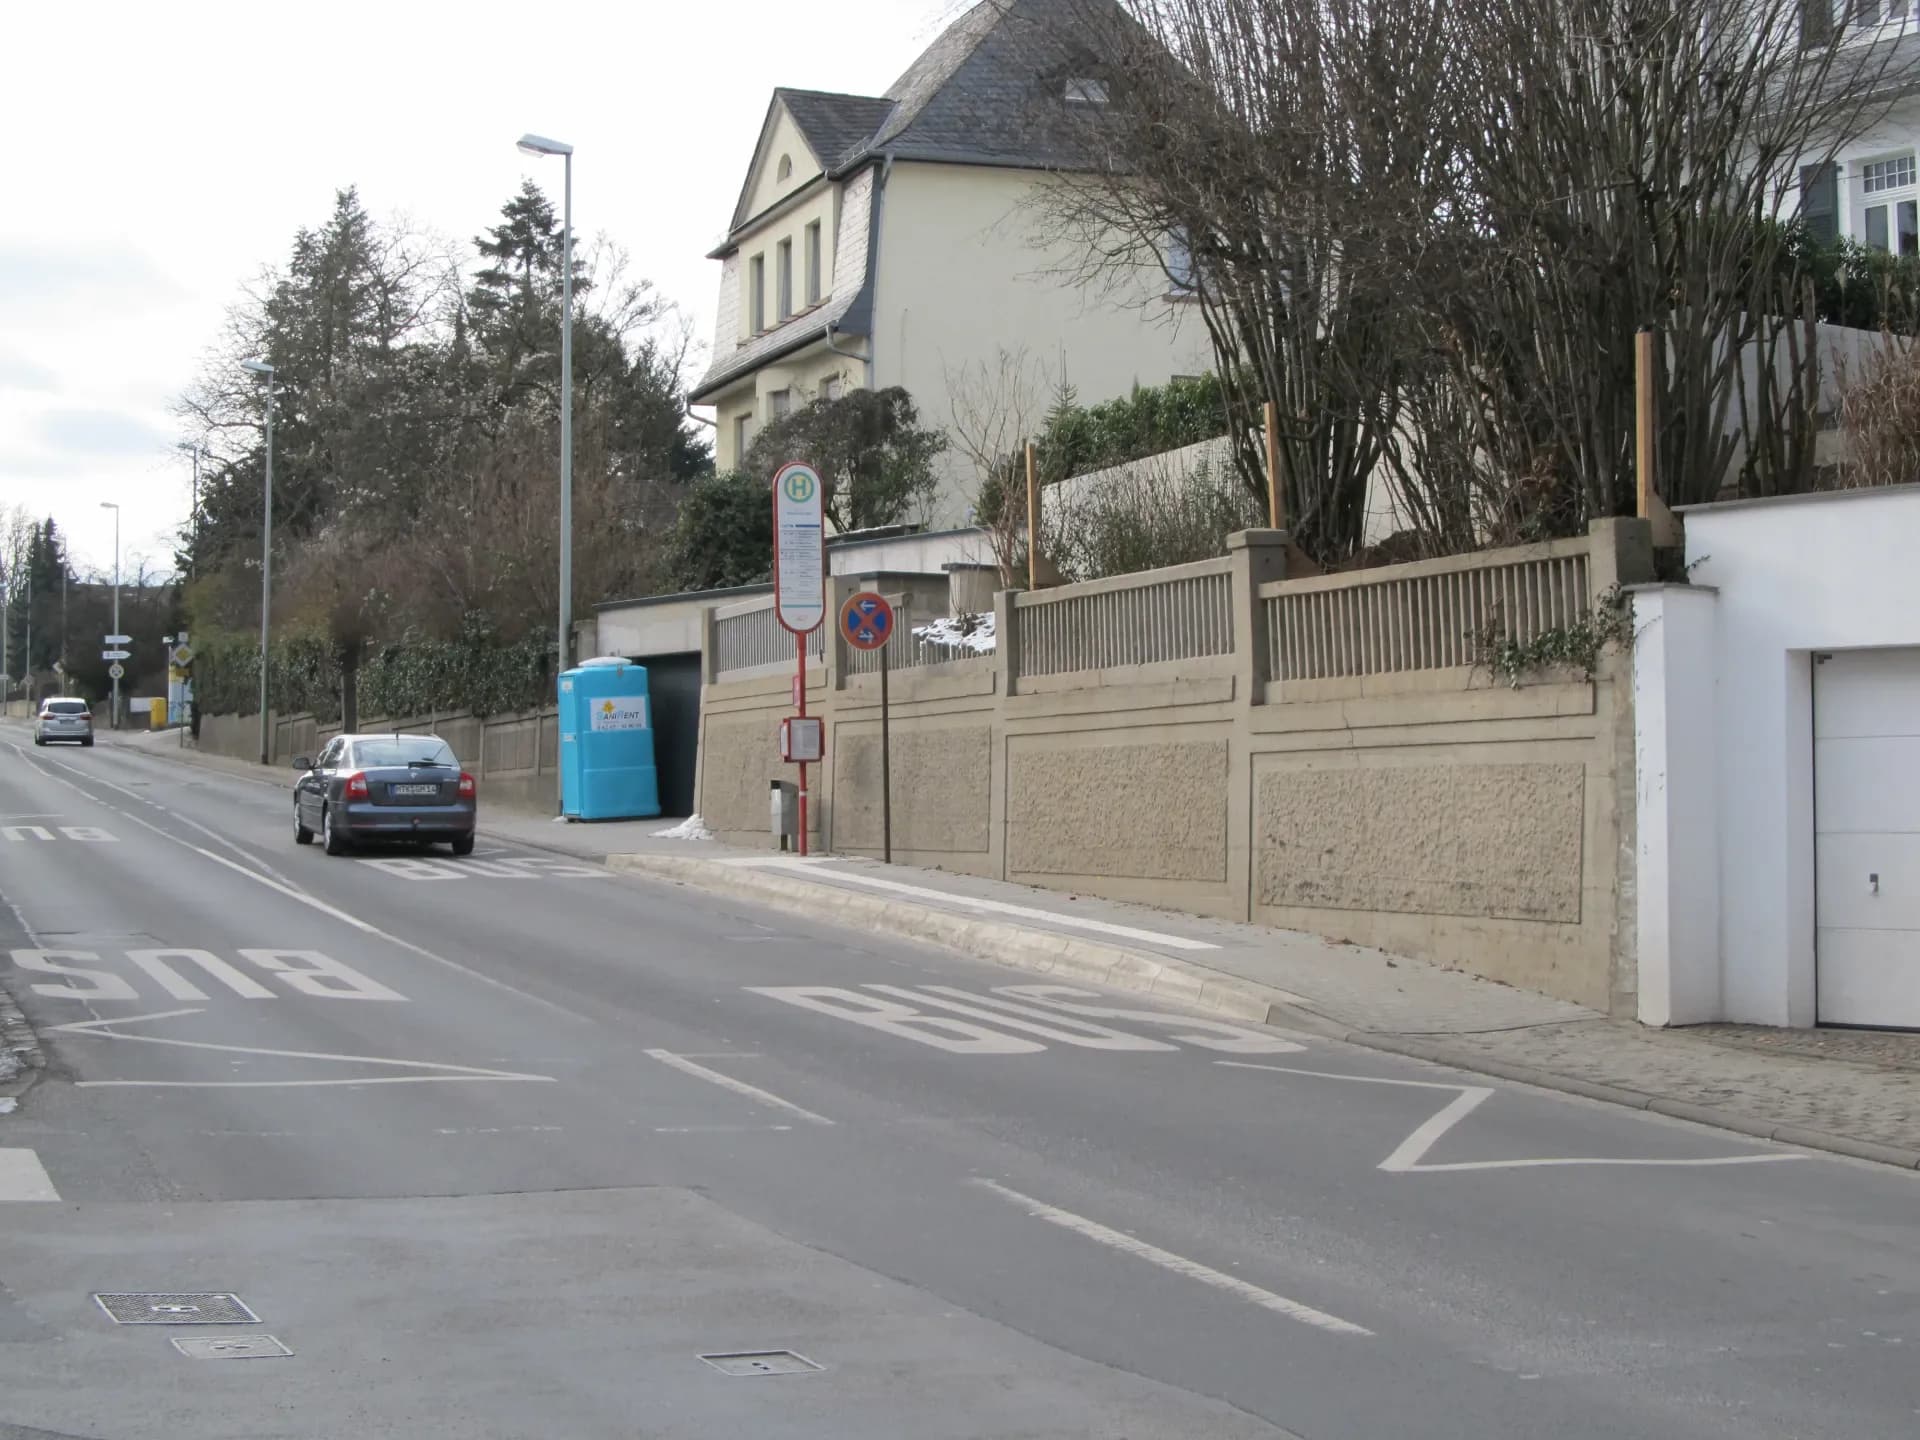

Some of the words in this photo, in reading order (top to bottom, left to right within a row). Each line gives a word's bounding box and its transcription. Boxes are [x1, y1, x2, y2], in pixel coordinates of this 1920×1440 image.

[792, 478, 806, 496] H
[0, 826, 120, 841] BU
[354, 857, 616, 880] BUS
[10, 948, 410, 1000] BUS
[740, 984, 1307, 1053] BUS
